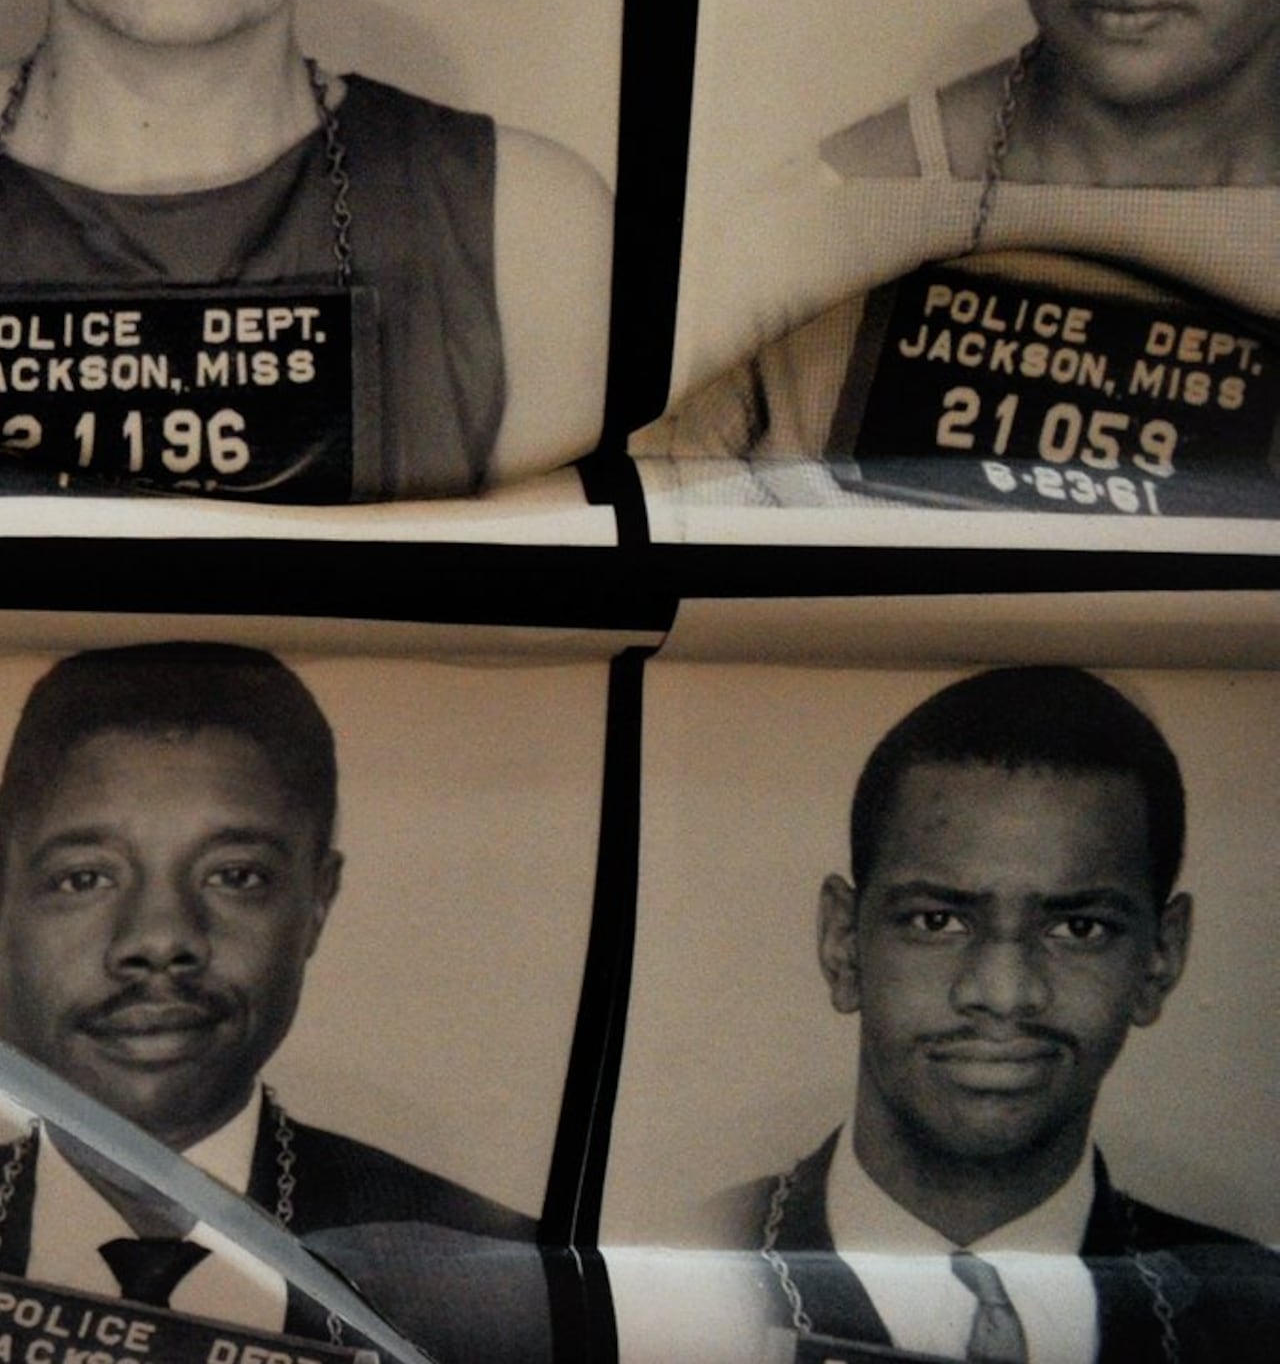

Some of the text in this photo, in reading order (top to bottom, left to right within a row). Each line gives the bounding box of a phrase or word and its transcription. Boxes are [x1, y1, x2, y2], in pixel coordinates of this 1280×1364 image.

[196, 349, 316, 387] MISS
[203, 307, 327, 344] DEPT.
[898, 324, 1246, 410] JACKSON, MISS
[924, 284, 1263, 376] POLICE DEPT.
[935, 385, 1179, 478] 21059
